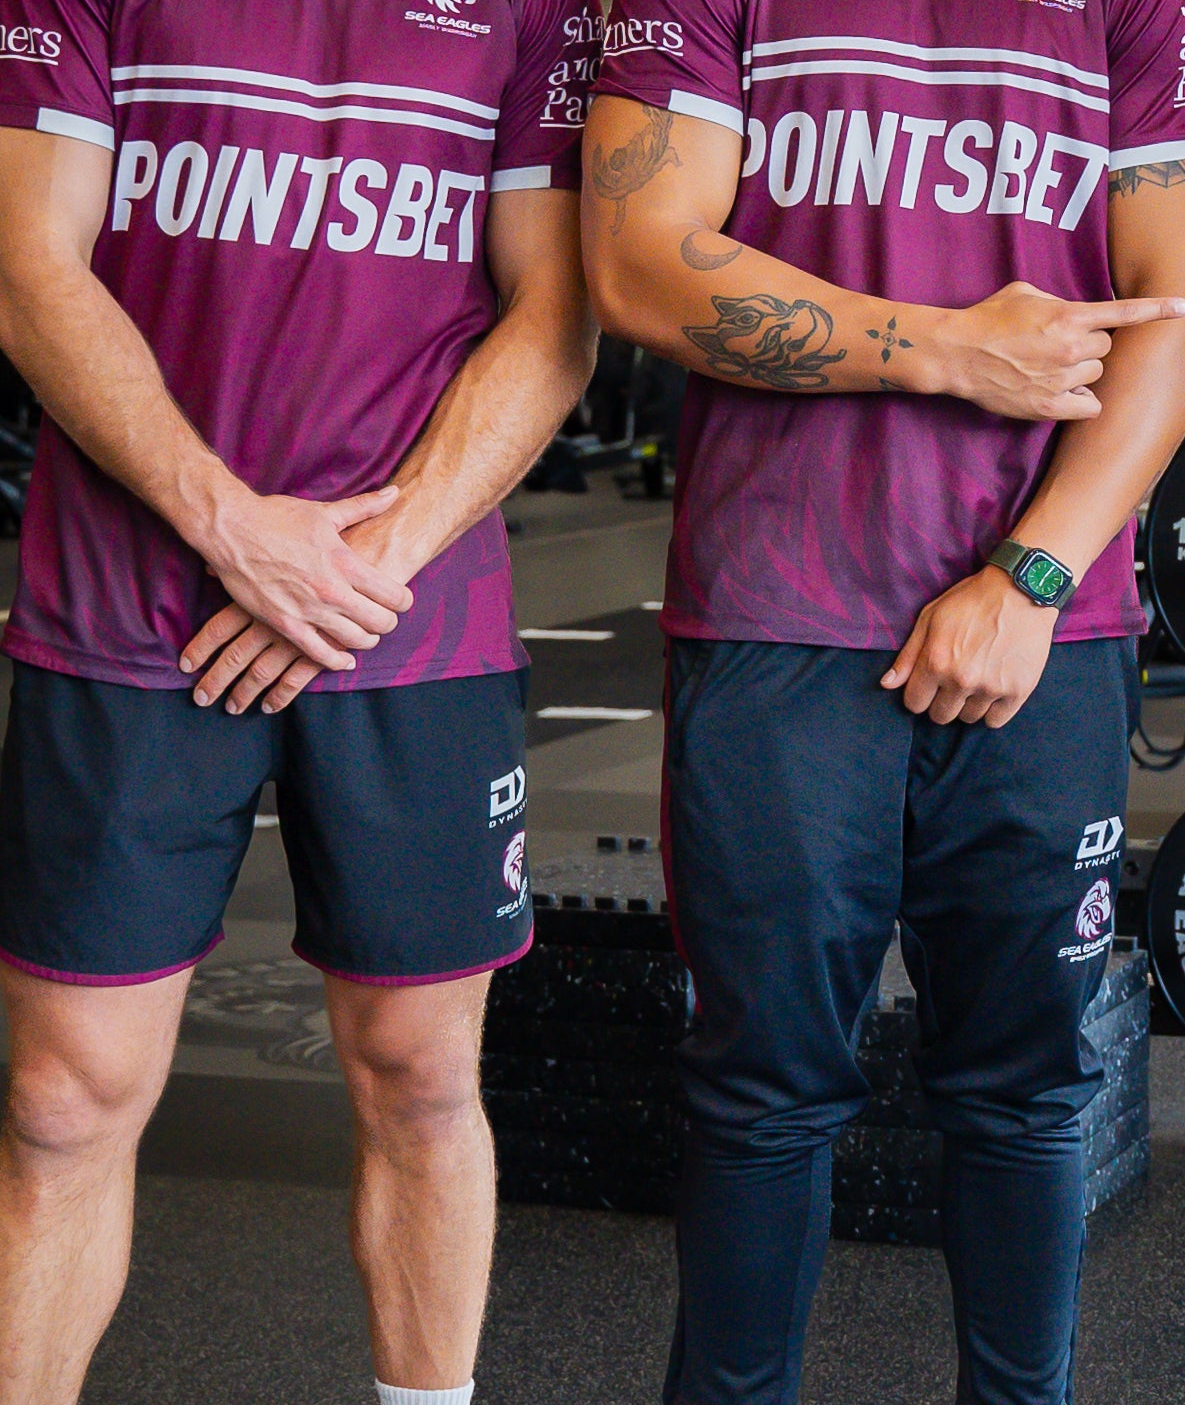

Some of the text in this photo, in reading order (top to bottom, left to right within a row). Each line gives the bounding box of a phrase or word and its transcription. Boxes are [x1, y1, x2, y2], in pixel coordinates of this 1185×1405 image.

[404, 10, 436, 24] SEA
[436, 16, 492, 35] EAGLES
[112, 140, 485, 263] POINTSBET
[1057, 945, 1082, 958] SEA
